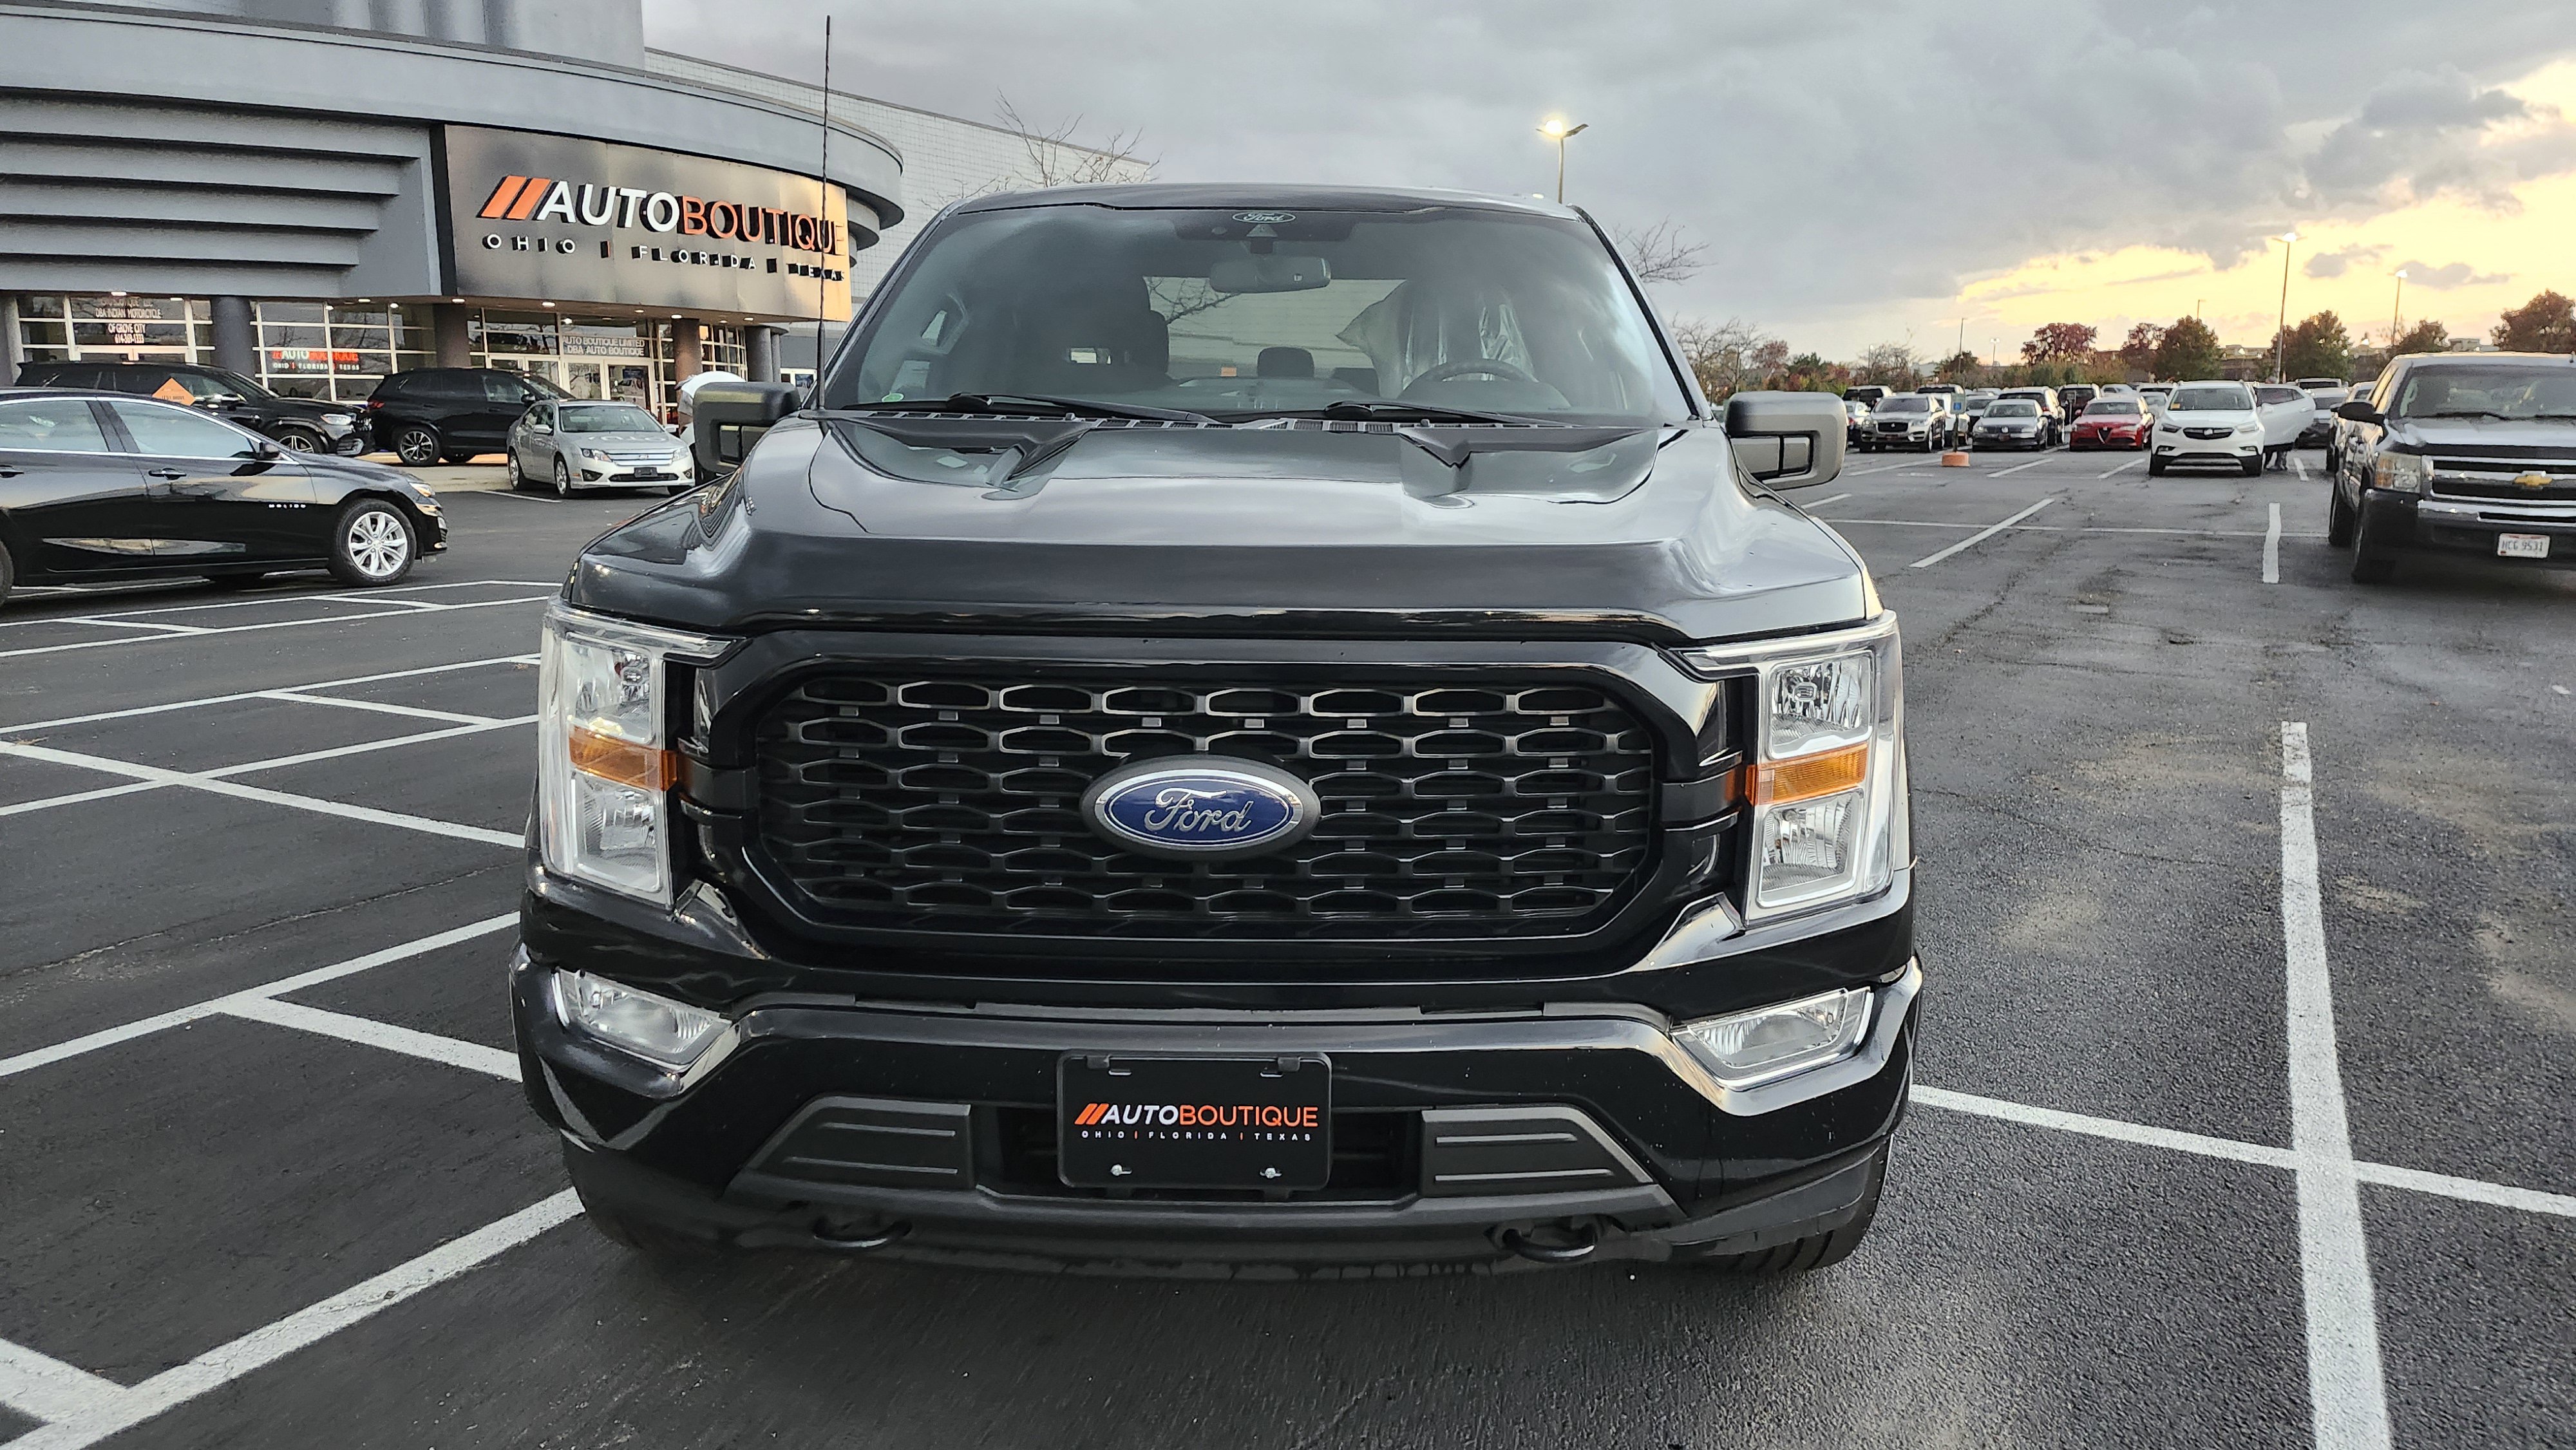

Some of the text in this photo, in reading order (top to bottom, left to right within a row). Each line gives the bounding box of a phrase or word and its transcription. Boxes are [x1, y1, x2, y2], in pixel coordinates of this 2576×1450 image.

[1244, 213, 1285, 222] Ford
[484, 233, 575, 254] OHIO
[634, 245, 756, 269] FLORIDA
[793, 263, 844, 281] TEXAS
[134, 323, 146, 334] CITY
[583, 337, 618, 346] BOUTIQUE
[567, 344, 645, 356] DBA AUTO BOUTIQUE
[1144, 787, 1254, 833] Ford
[1081, 1131, 1125, 1139] OHIO
[1149, 1131, 1227, 1140] FLORIDA
[1255, 1133, 1311, 1142] TEXAS
